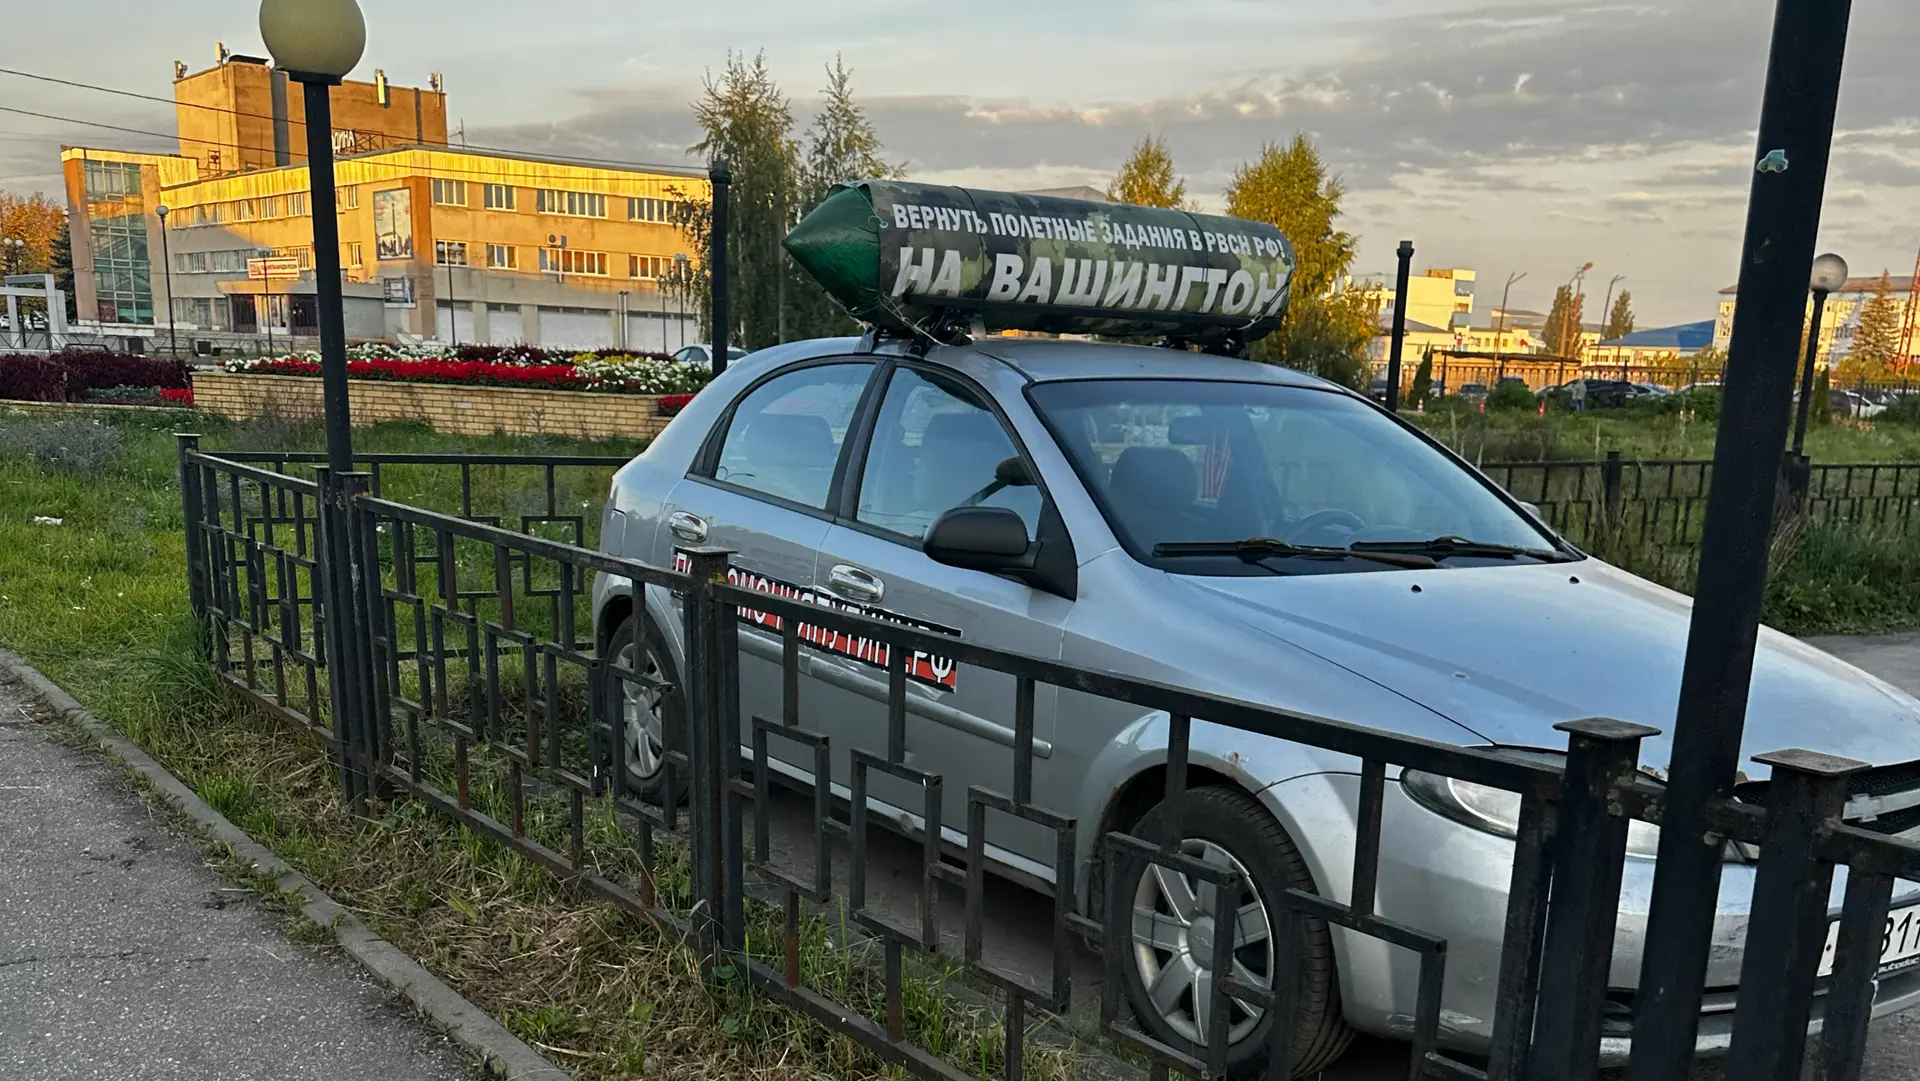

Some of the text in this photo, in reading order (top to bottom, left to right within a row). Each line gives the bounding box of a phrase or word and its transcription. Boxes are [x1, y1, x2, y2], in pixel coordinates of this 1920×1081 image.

[892, 203, 1286, 258] ВЕРНУТЬ ПОЛЕТНЫЕ ЗАДАНИЯ В РВСН РФ!
[891, 246, 1287, 316] НА ВАШИНГТОН
